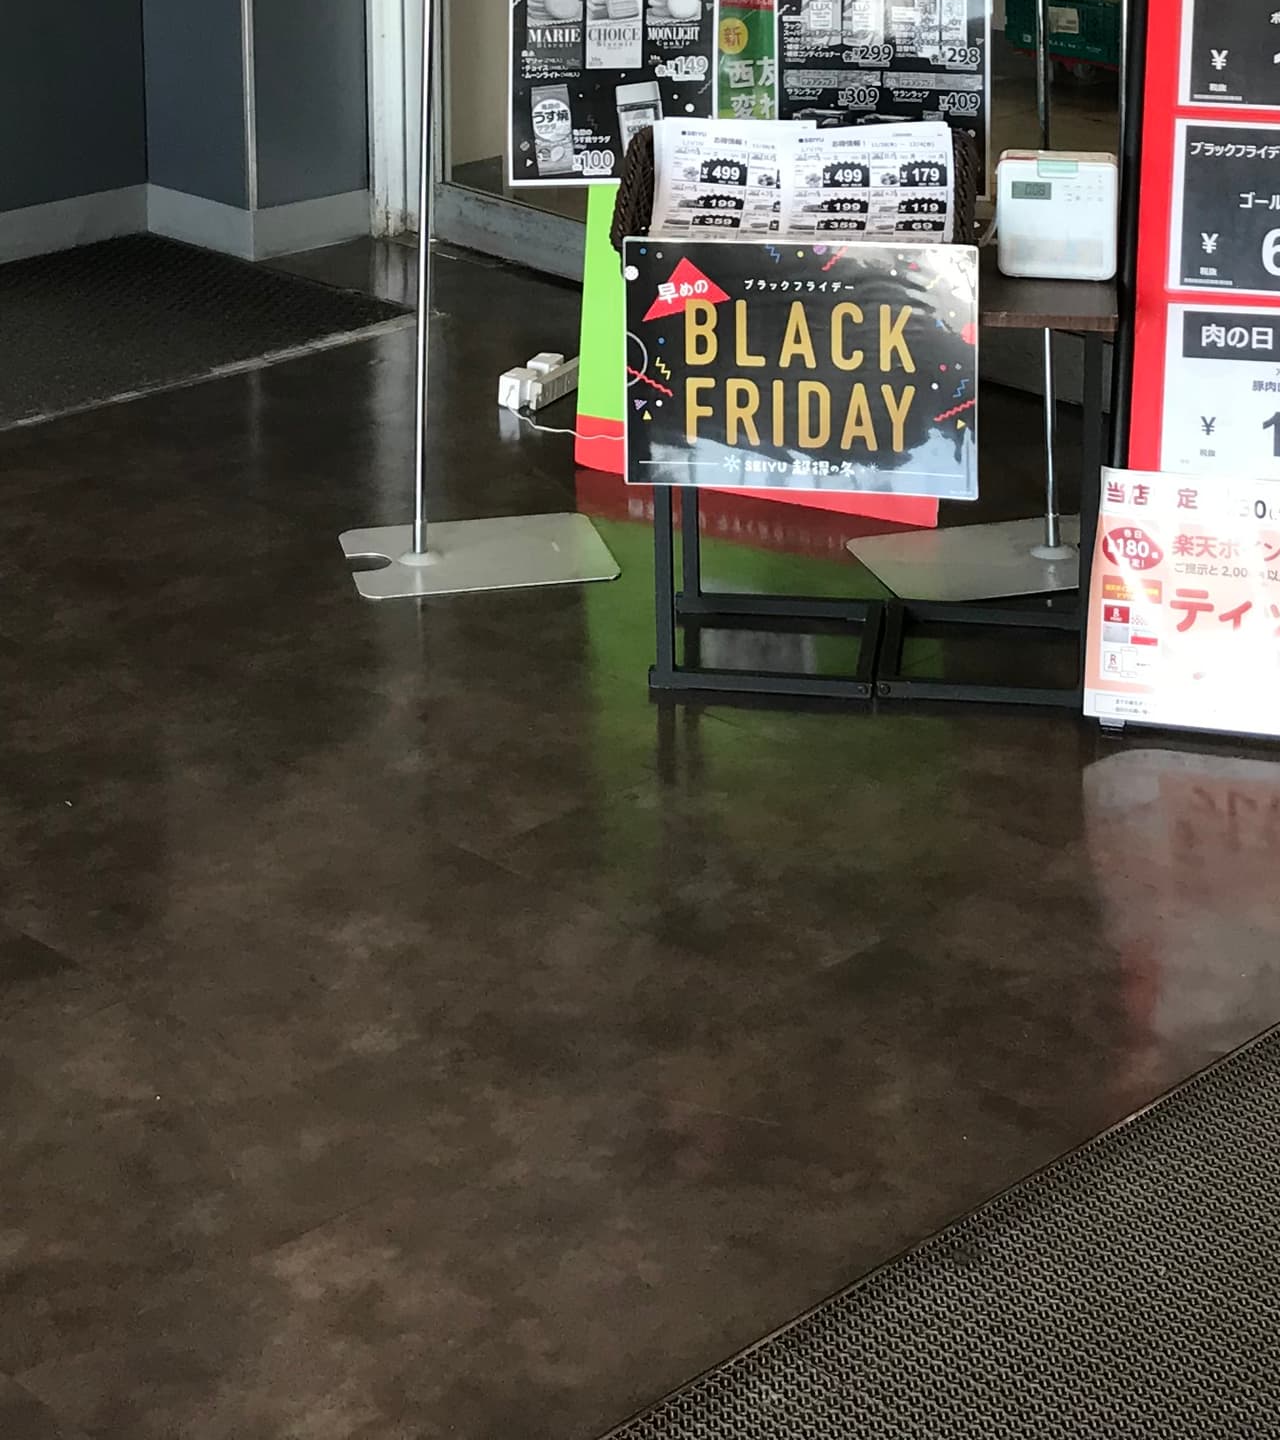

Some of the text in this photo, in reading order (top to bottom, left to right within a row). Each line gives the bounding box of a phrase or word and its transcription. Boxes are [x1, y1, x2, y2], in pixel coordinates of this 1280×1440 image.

[528, 28, 581, 43] MARIE
[588, 28, 640, 41] CHOICE
[647, 27, 700, 41] MOONLIGHT
[722, 26, 740, 48] 新
[1211, 50, 1228, 70] ¥
[712, 166, 740, 180] 499
[834, 169, 863, 183] 499
[912, 168, 940, 181] 179
[1201, 233, 1219, 253] ¥
[658, 280, 708, 303] 早めの
[744, 279, 855, 292] ブラックフライデー
[684, 299, 916, 372] BLACK
[1201, 324, 1273, 349] 肉の日
[686, 378, 916, 452] FRIDAY
[1201, 416, 1216, 436] ¥
[744, 460, 788, 473] SEIYU
